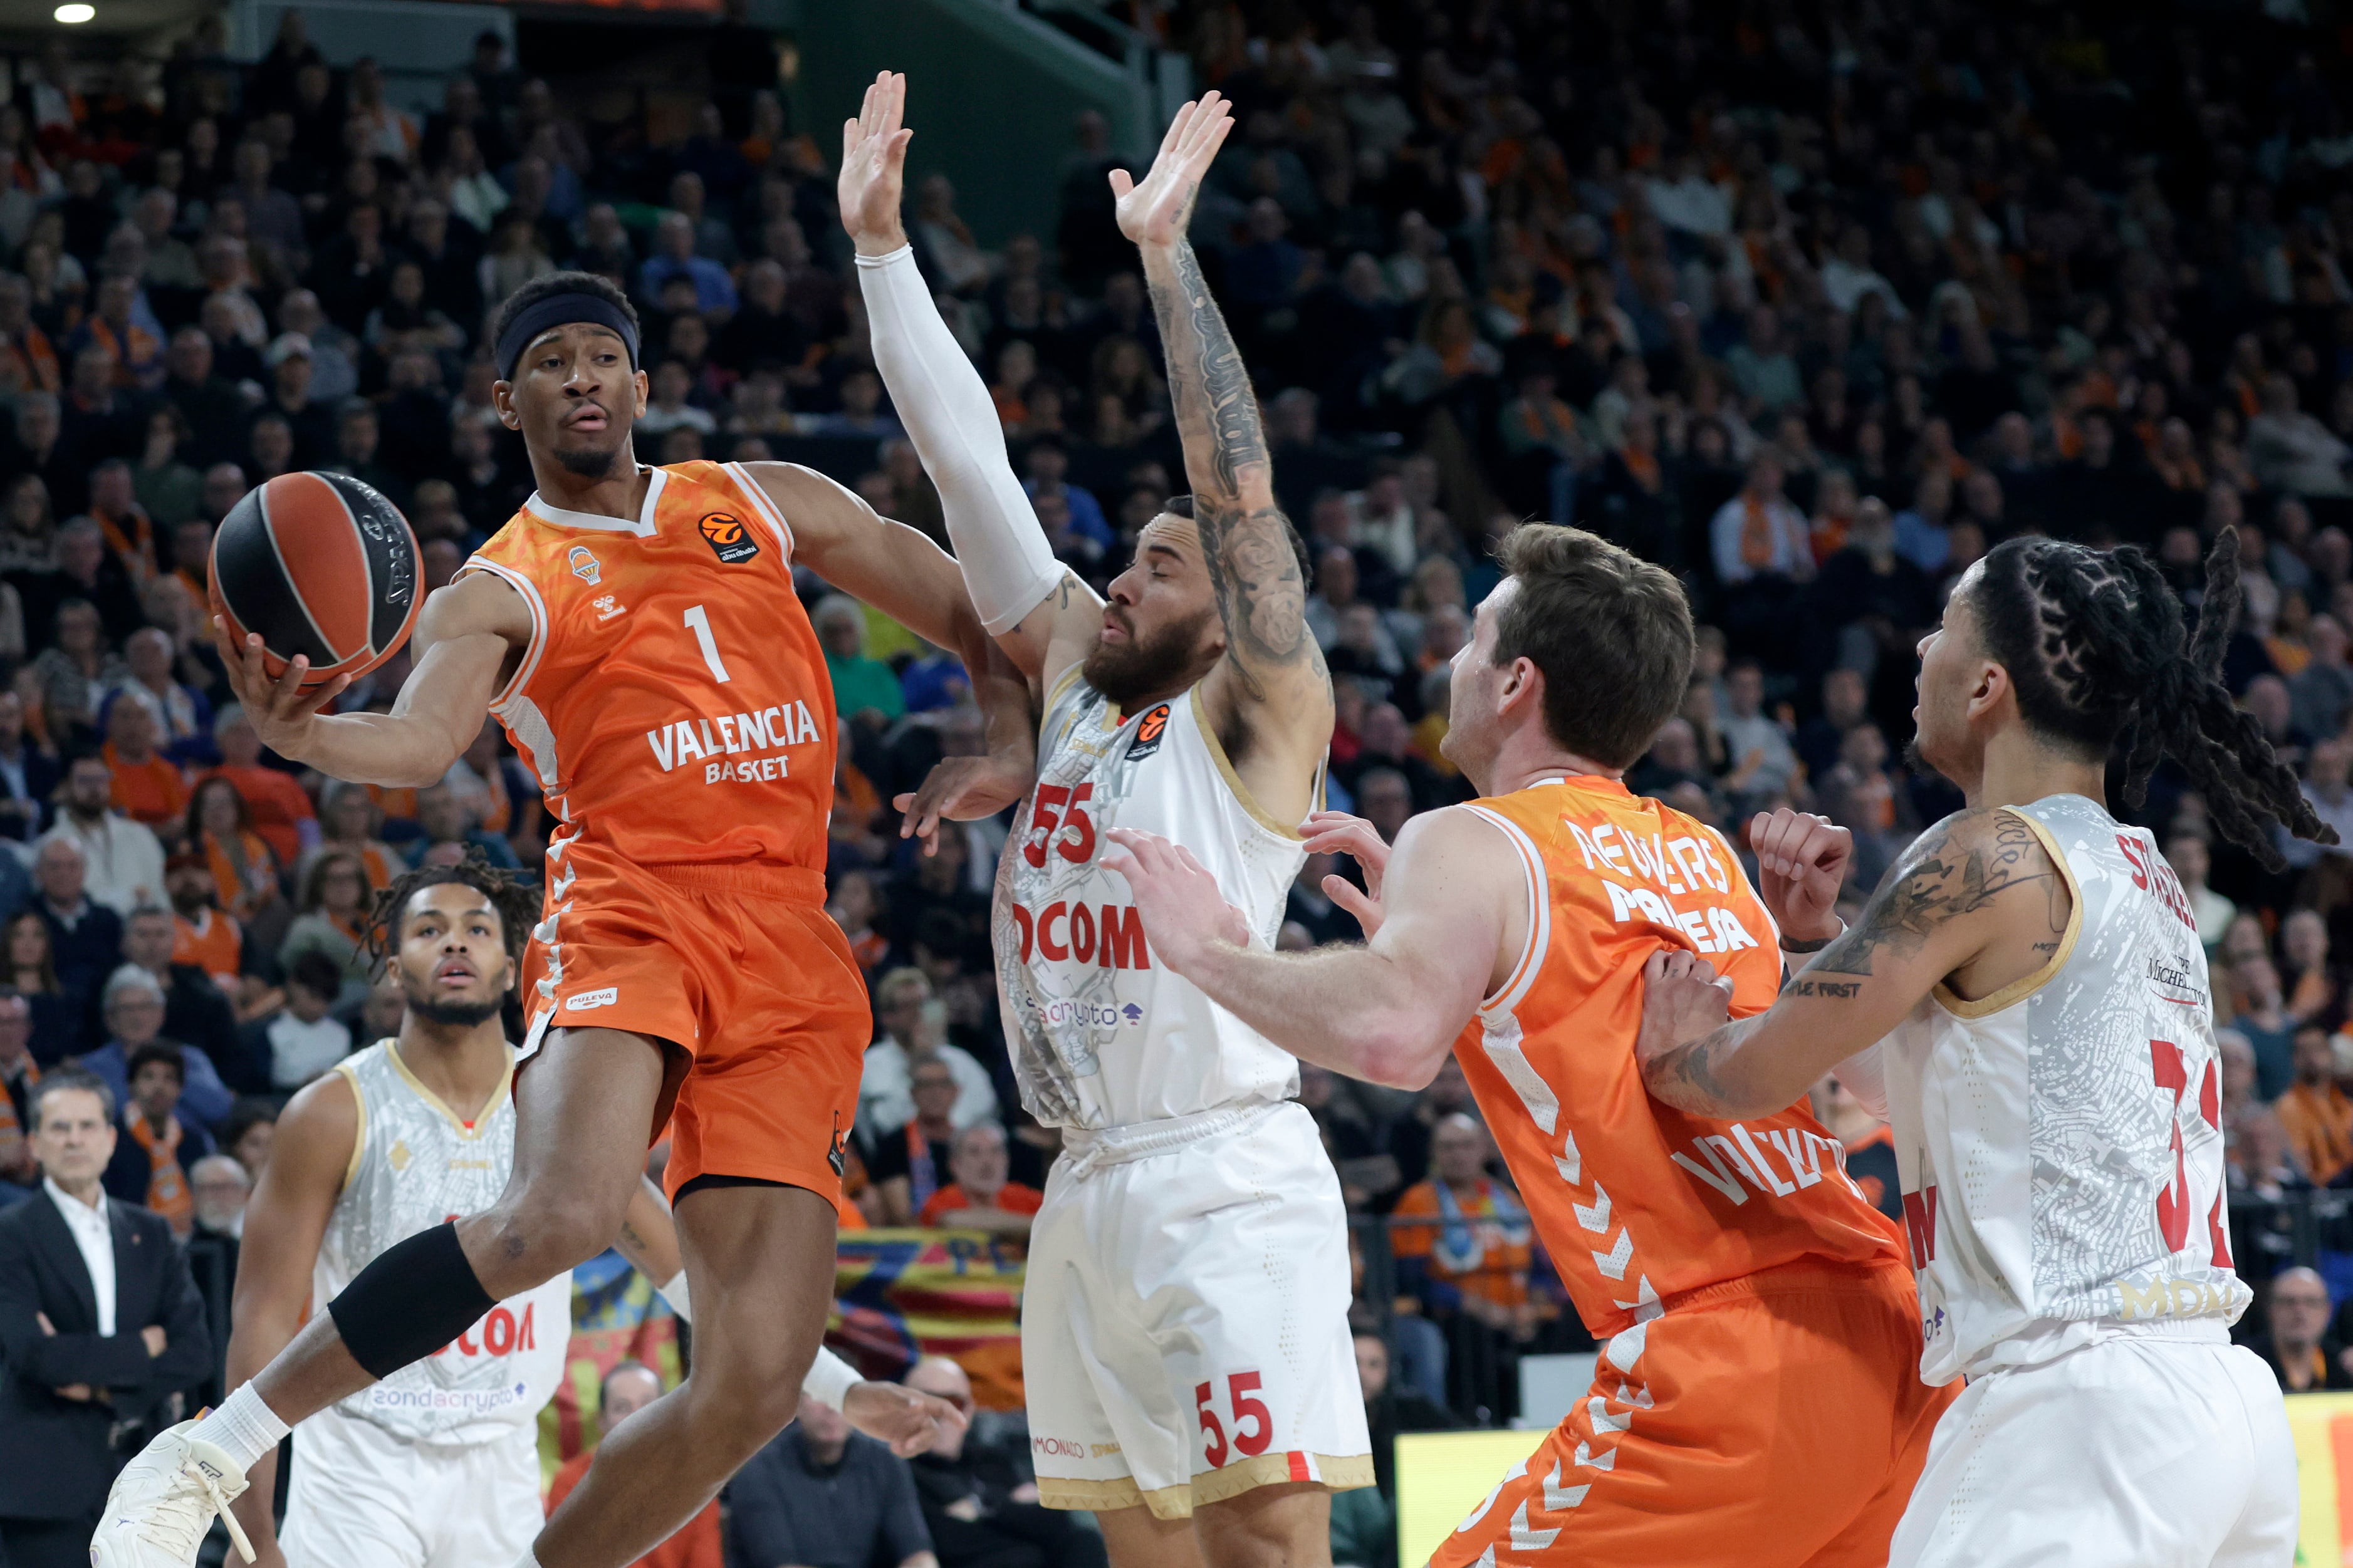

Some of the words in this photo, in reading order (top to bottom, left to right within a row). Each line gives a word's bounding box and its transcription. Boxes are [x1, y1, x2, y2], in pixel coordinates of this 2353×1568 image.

[597, 605, 627, 621] hummel
[684, 604, 731, 683] 1
[647, 700, 820, 772] VALENCIA
[705, 755, 789, 785] BASKET
[1024, 782, 1095, 868] 55
[570, 992, 612, 1005] PULEVA
[1818, 982, 1862, 998] FIRST
[1195, 1370, 1273, 1468] 55
